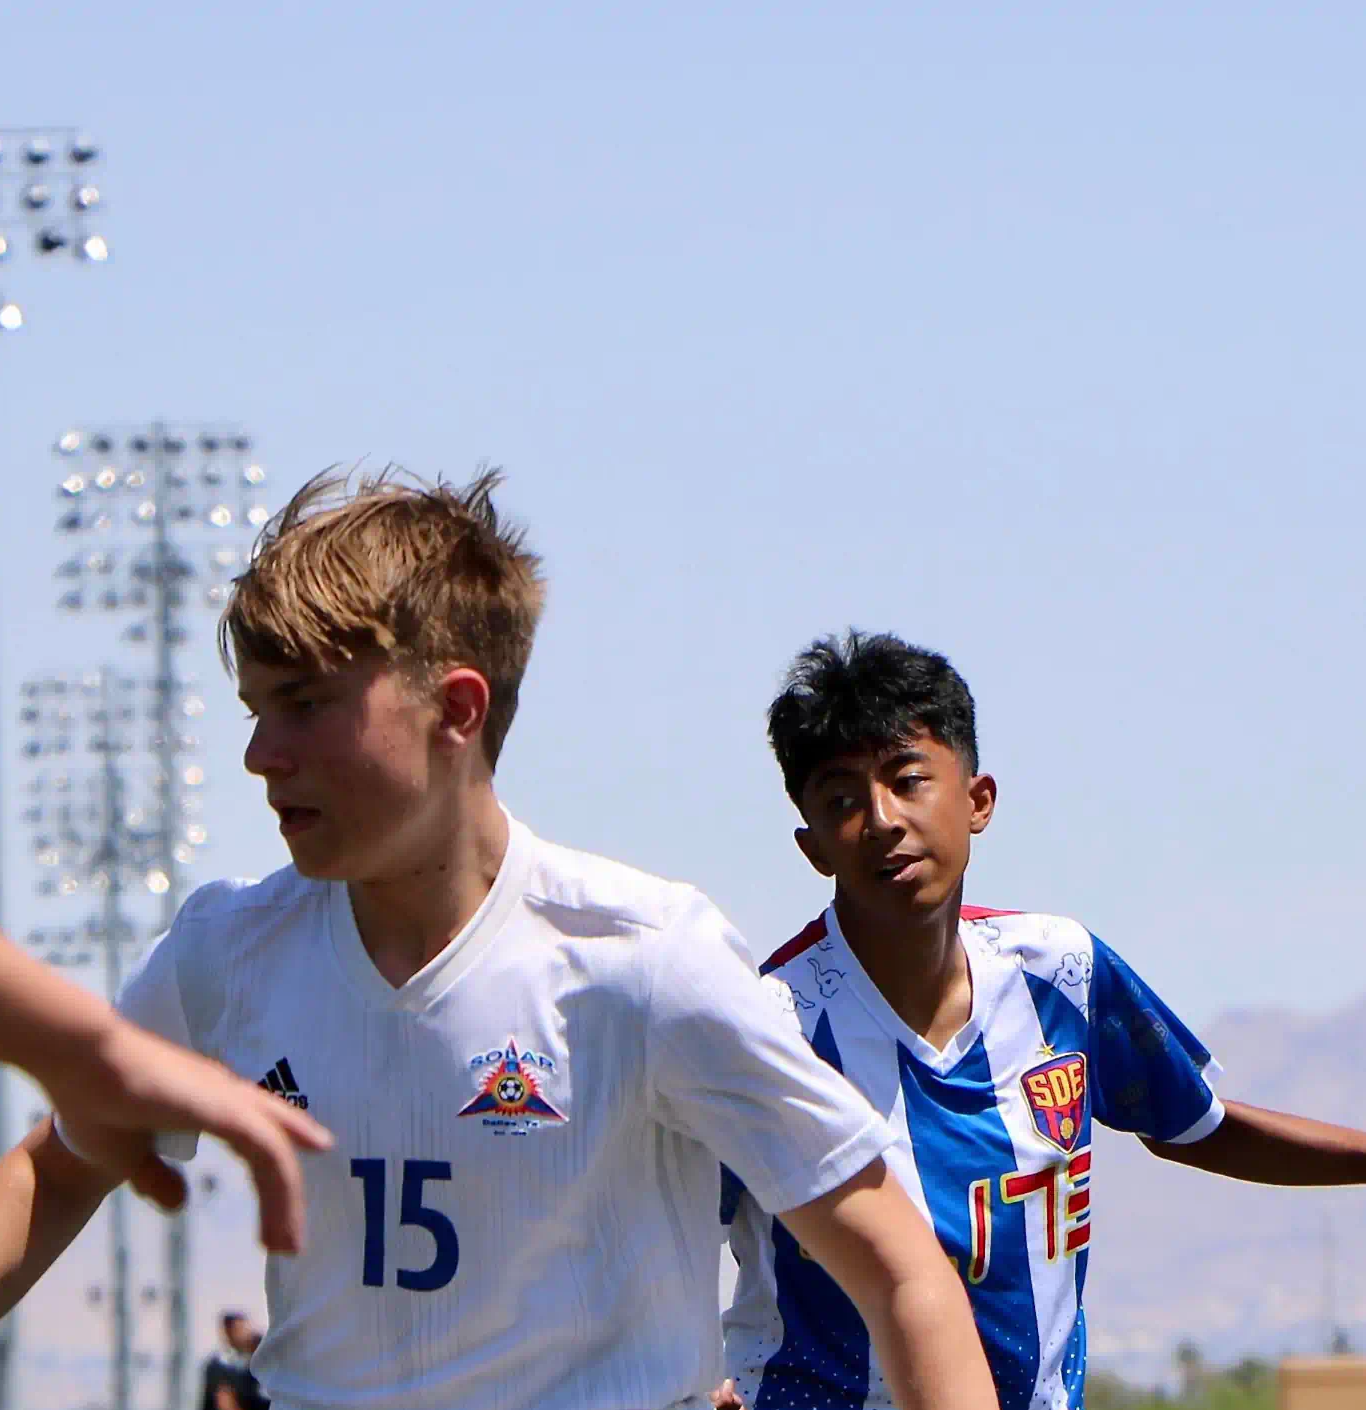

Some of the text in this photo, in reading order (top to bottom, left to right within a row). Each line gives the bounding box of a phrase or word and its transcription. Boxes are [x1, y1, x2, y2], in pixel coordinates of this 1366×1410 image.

[469, 1048, 556, 1072] SOLAR
[1027, 1062, 1084, 1108] SDE
[349, 1157, 460, 1292] 15
